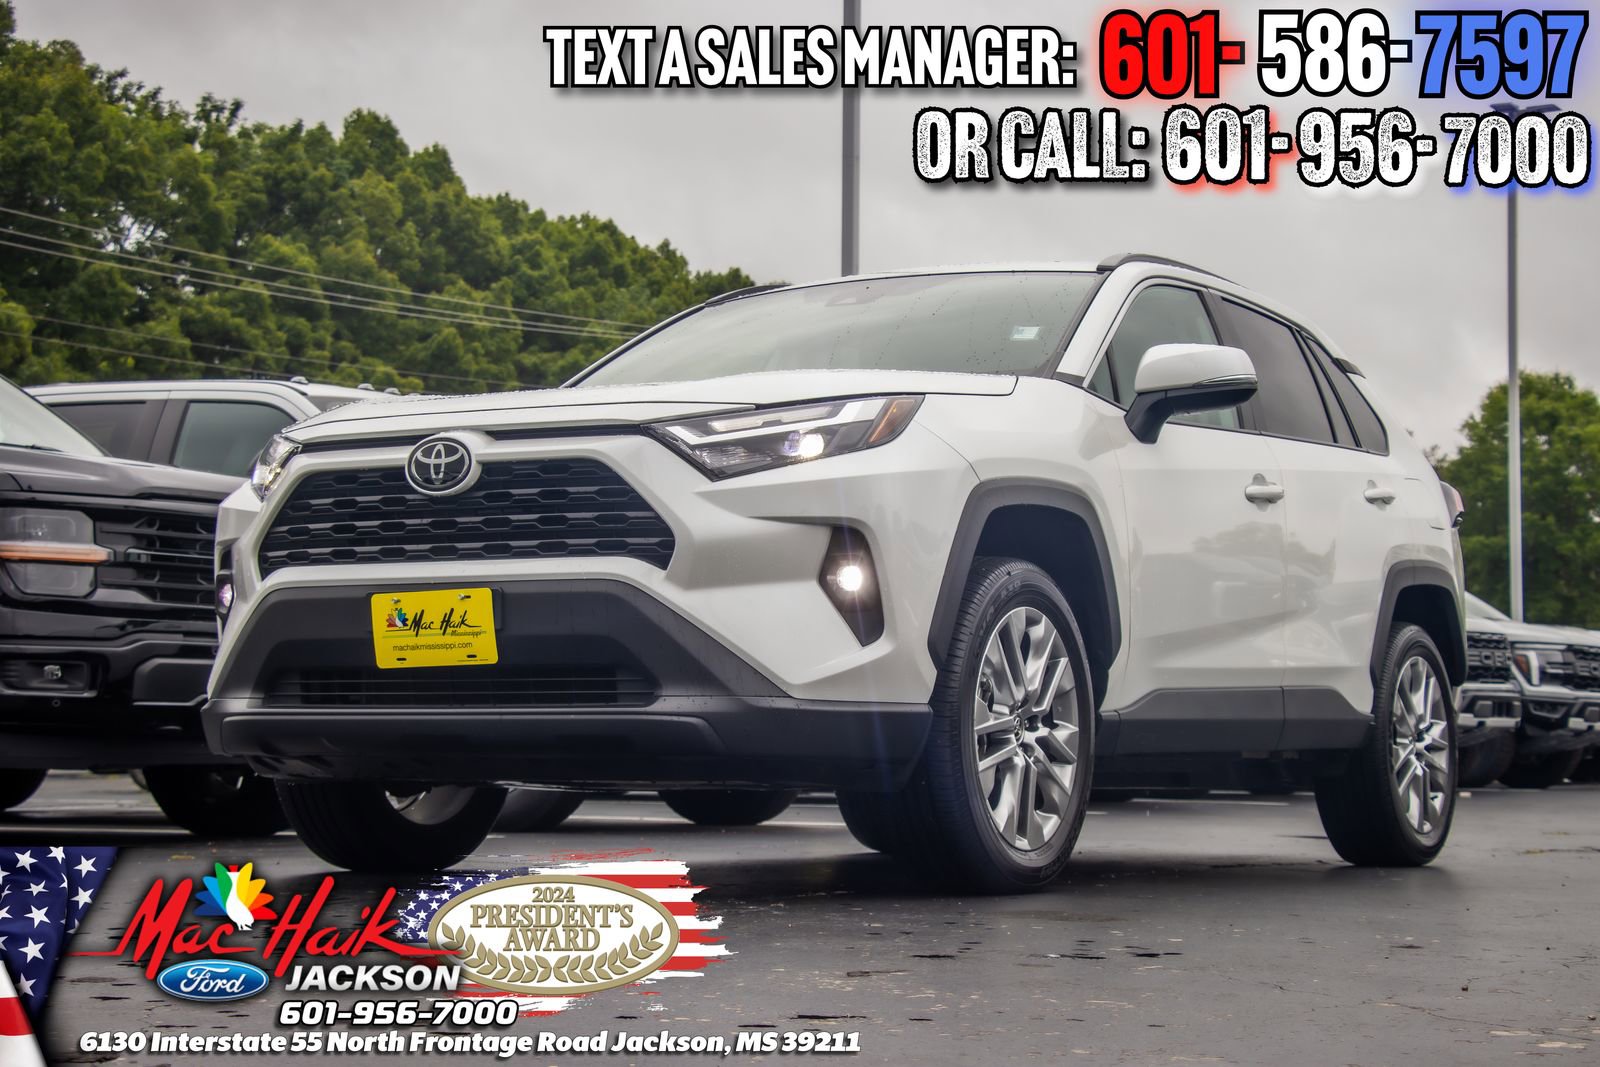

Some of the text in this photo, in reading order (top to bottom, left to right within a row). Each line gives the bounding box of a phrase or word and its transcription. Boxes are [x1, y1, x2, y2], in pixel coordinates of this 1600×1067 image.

[396, 608, 482, 637] Mac Haik
[393, 642, 473, 652] machaikmississippi.com
